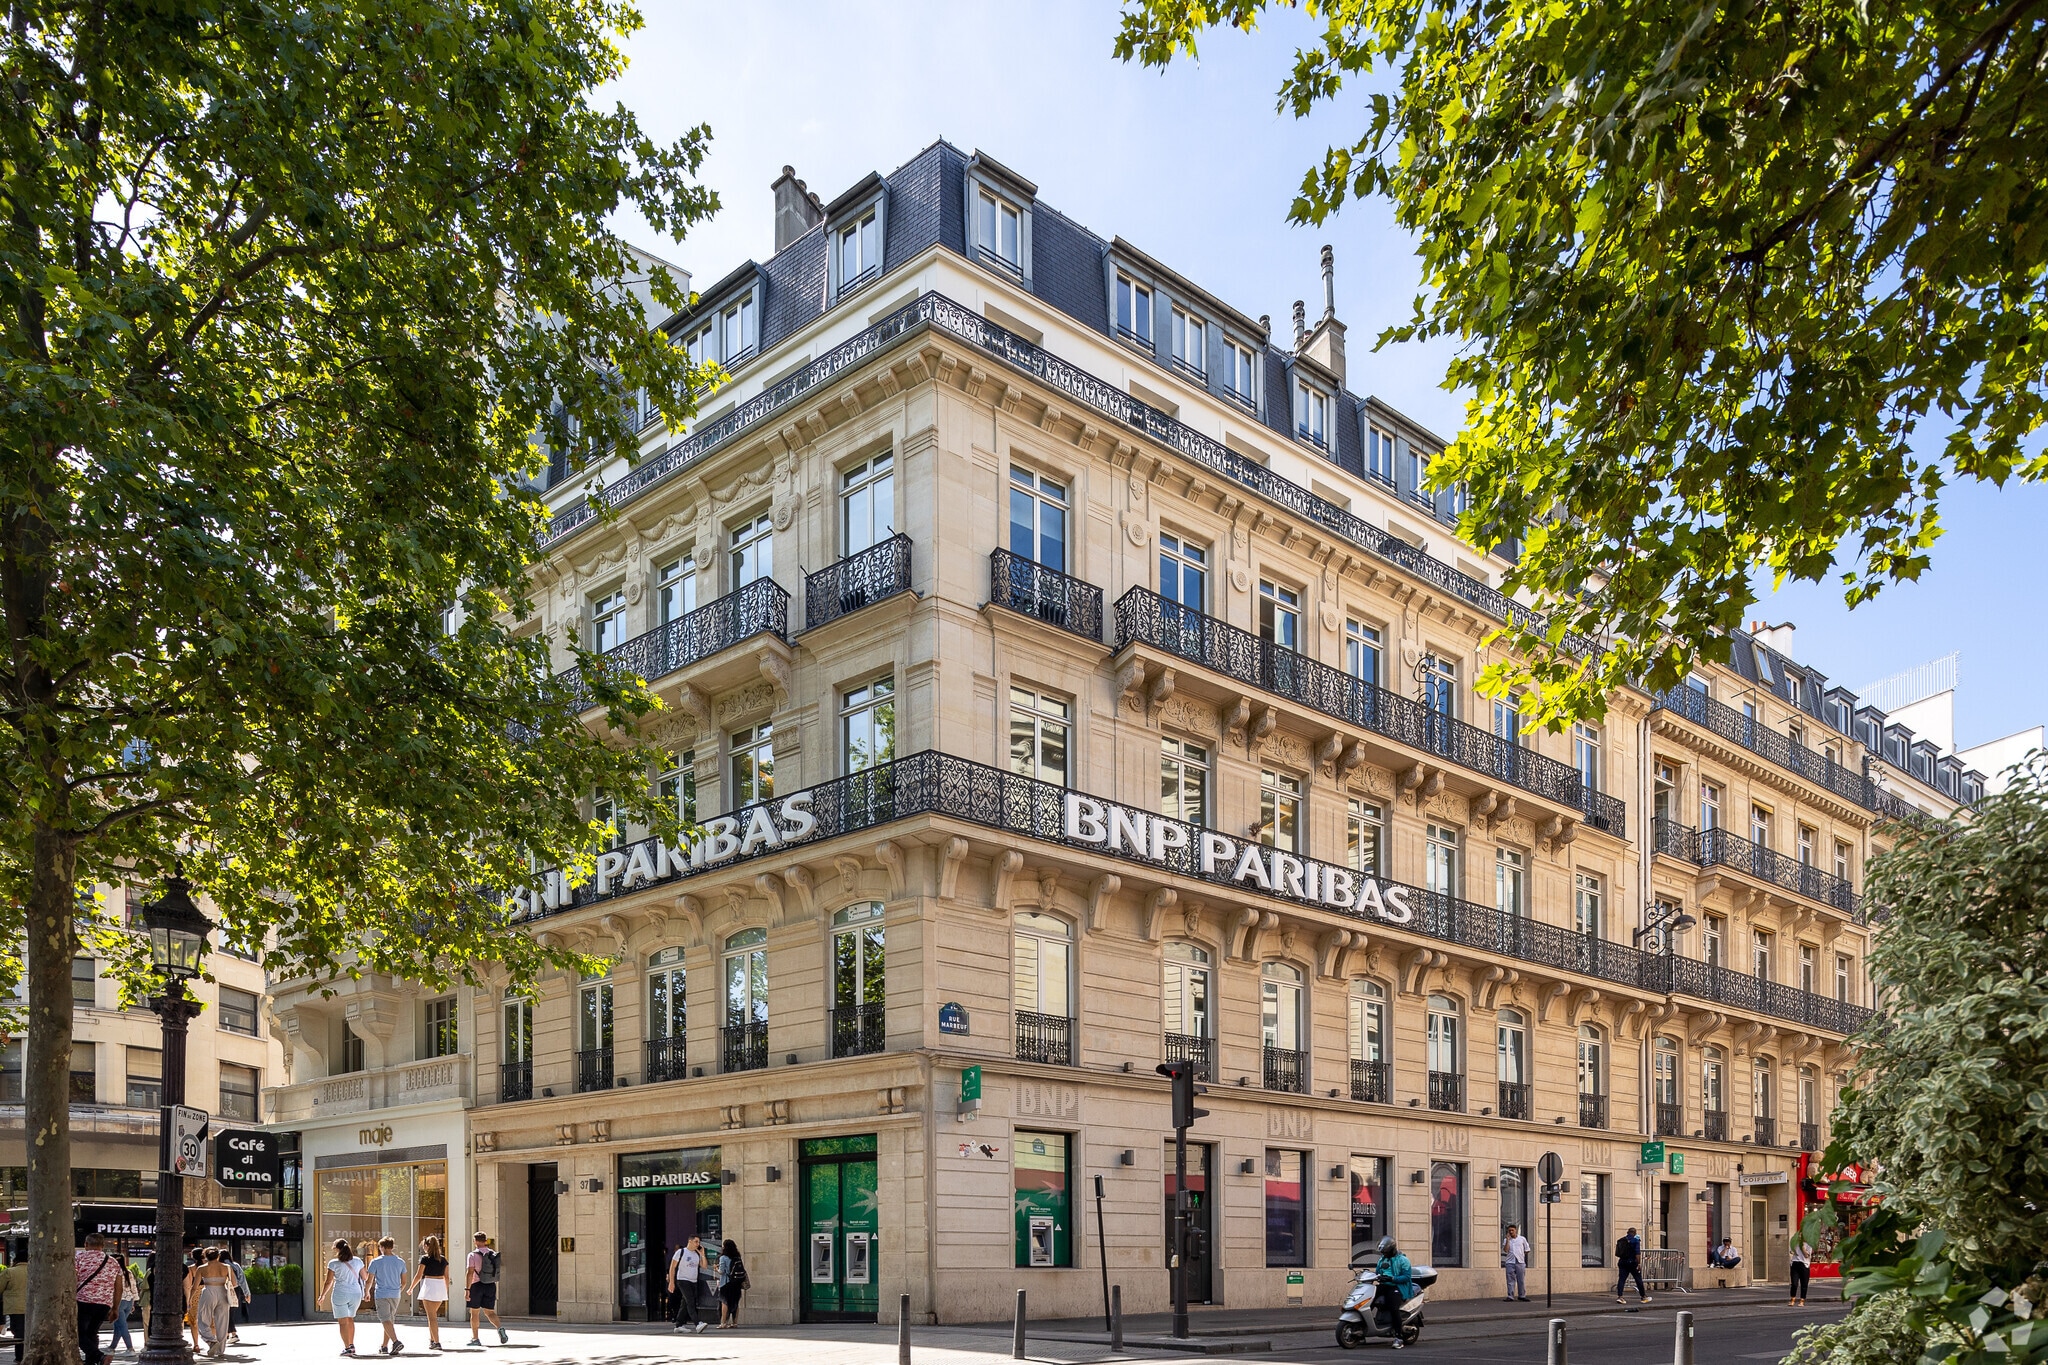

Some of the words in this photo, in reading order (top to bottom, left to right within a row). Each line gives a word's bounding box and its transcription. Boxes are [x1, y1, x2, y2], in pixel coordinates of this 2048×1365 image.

[597, 792, 817, 895] PARIBAS
[1063, 792, 1187, 861] BNP
[1201, 831, 1412, 924] PARIBAS
[941, 1021, 968, 1030] MARBEUF
[948, 1015, 960, 1023] RUE
[1020, 1080, 1078, 1116] BNP
[178, 1109, 187, 1119] FIN
[192, 1112, 206, 1123] ZONE
[1269, 1107, 1312, 1138] BNP
[359, 1123, 393, 1146] maje
[1434, 1124, 1468, 1152] BNP
[183, 1143, 197, 1158] 30
[228, 1137, 265, 1152] Café
[1584, 1139, 1610, 1165] BNP
[241, 1155, 254, 1165] di
[1708, 1155, 1729, 1177] BNP
[222, 1167, 272, 1182] Roma
[622, 1175, 651, 1188] BNP
[652, 1171, 711, 1186] PARIBAS
[580, 1180, 589, 1190] 37
[1352, 1202, 1377, 1215] PROJETS
[209, 1226, 285, 1237] RISTORANTE
